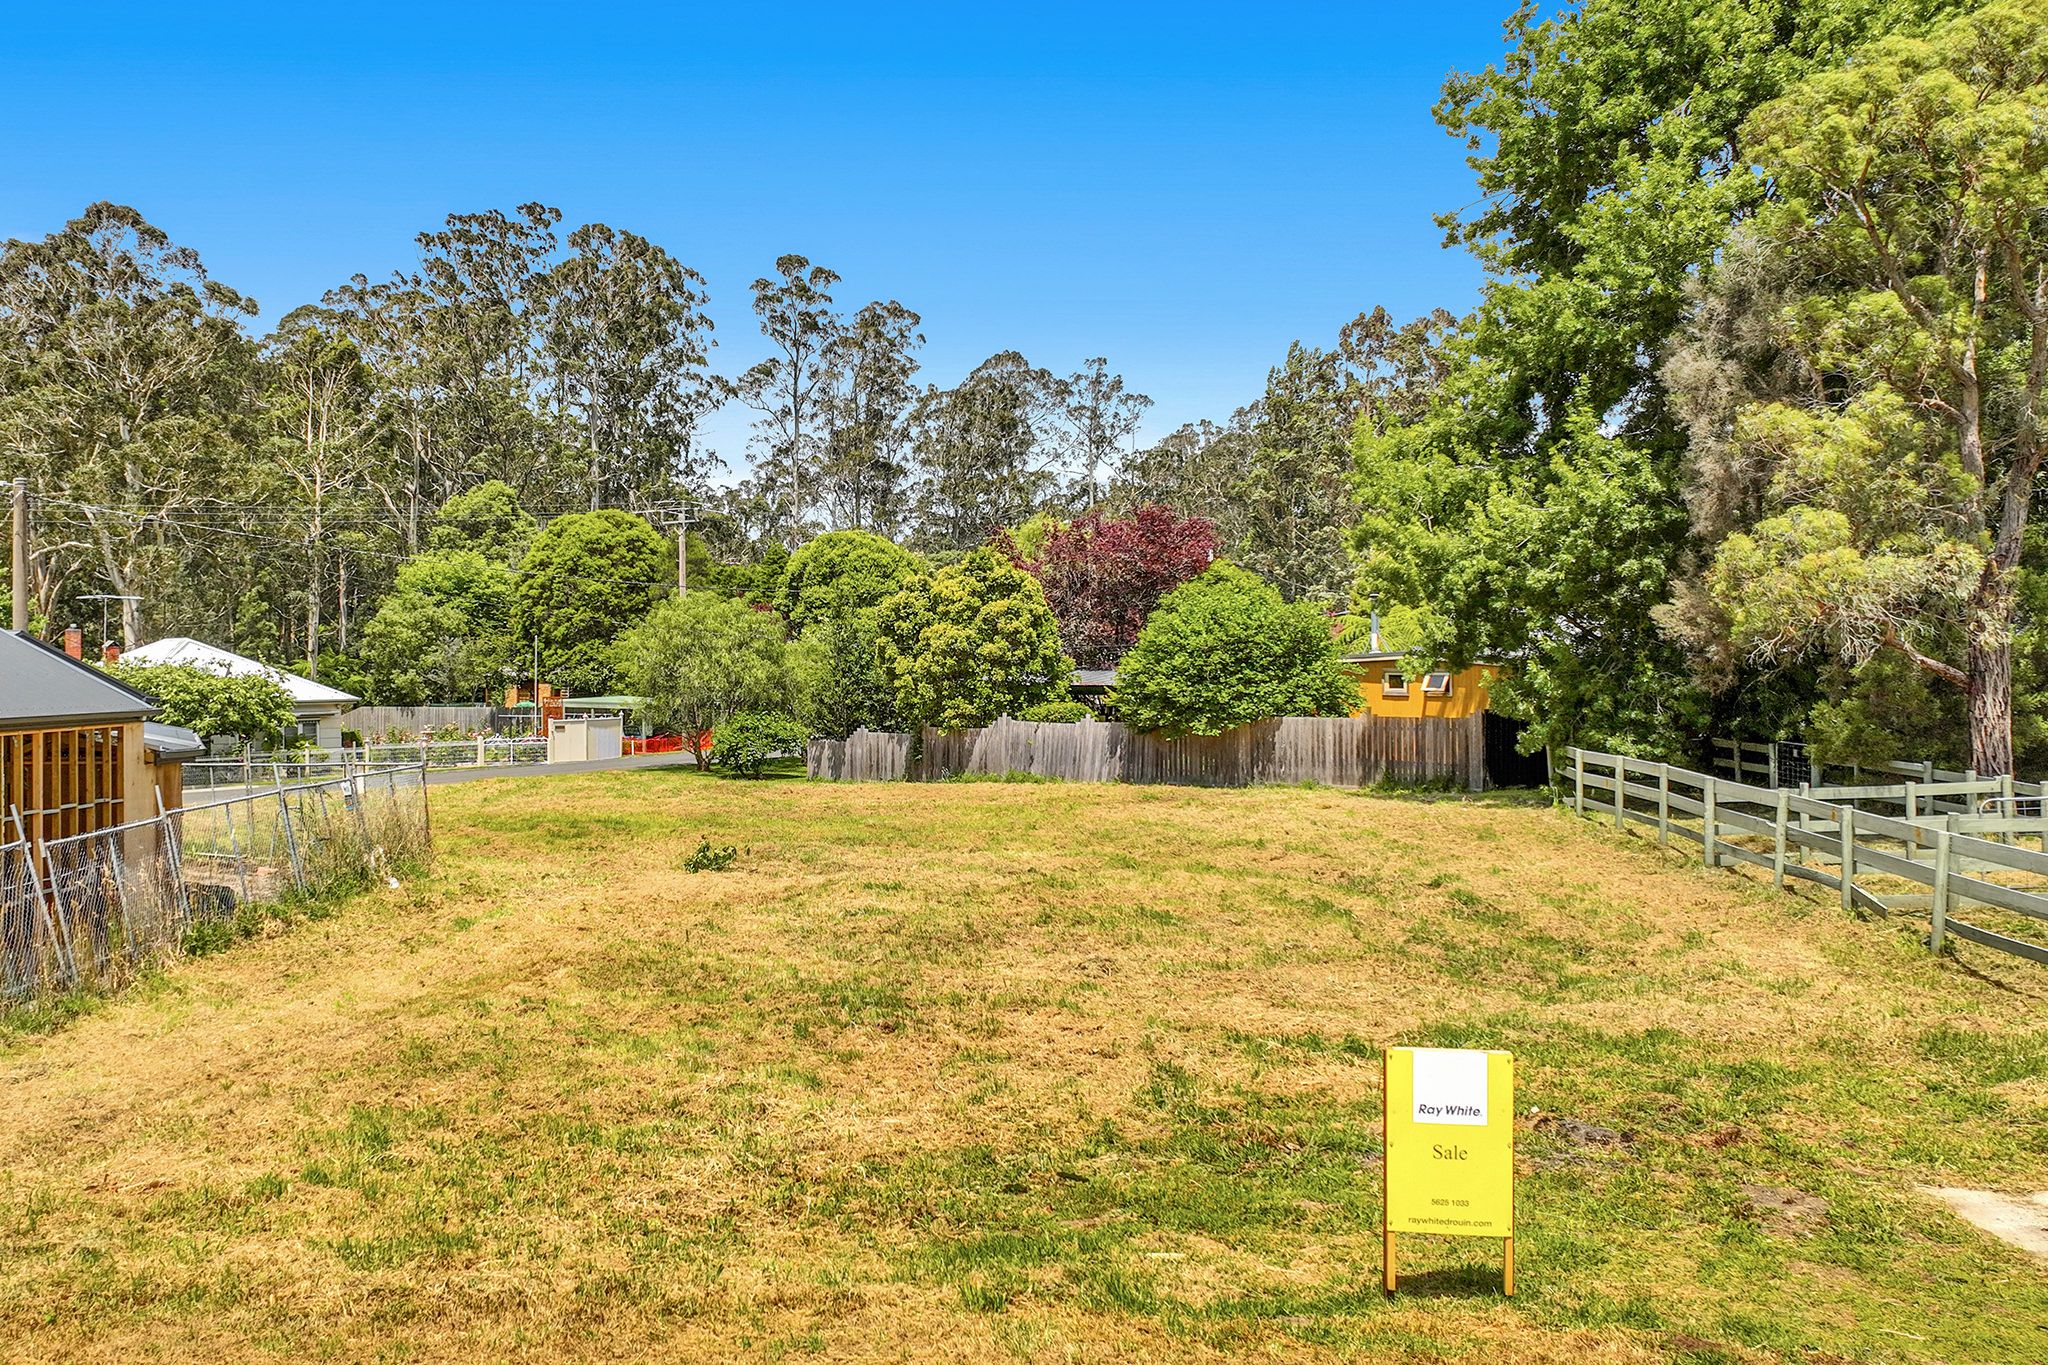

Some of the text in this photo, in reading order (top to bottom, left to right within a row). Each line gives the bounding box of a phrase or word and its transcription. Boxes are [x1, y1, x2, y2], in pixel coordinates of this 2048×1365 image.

[1418, 1103, 1443, 1117] Ray
[1432, 1143, 1468, 1161] Sale
[1431, 1198, 1470, 1207] 5625 1033
[1408, 1216, 1493, 1227] raywhitedrouin.com
